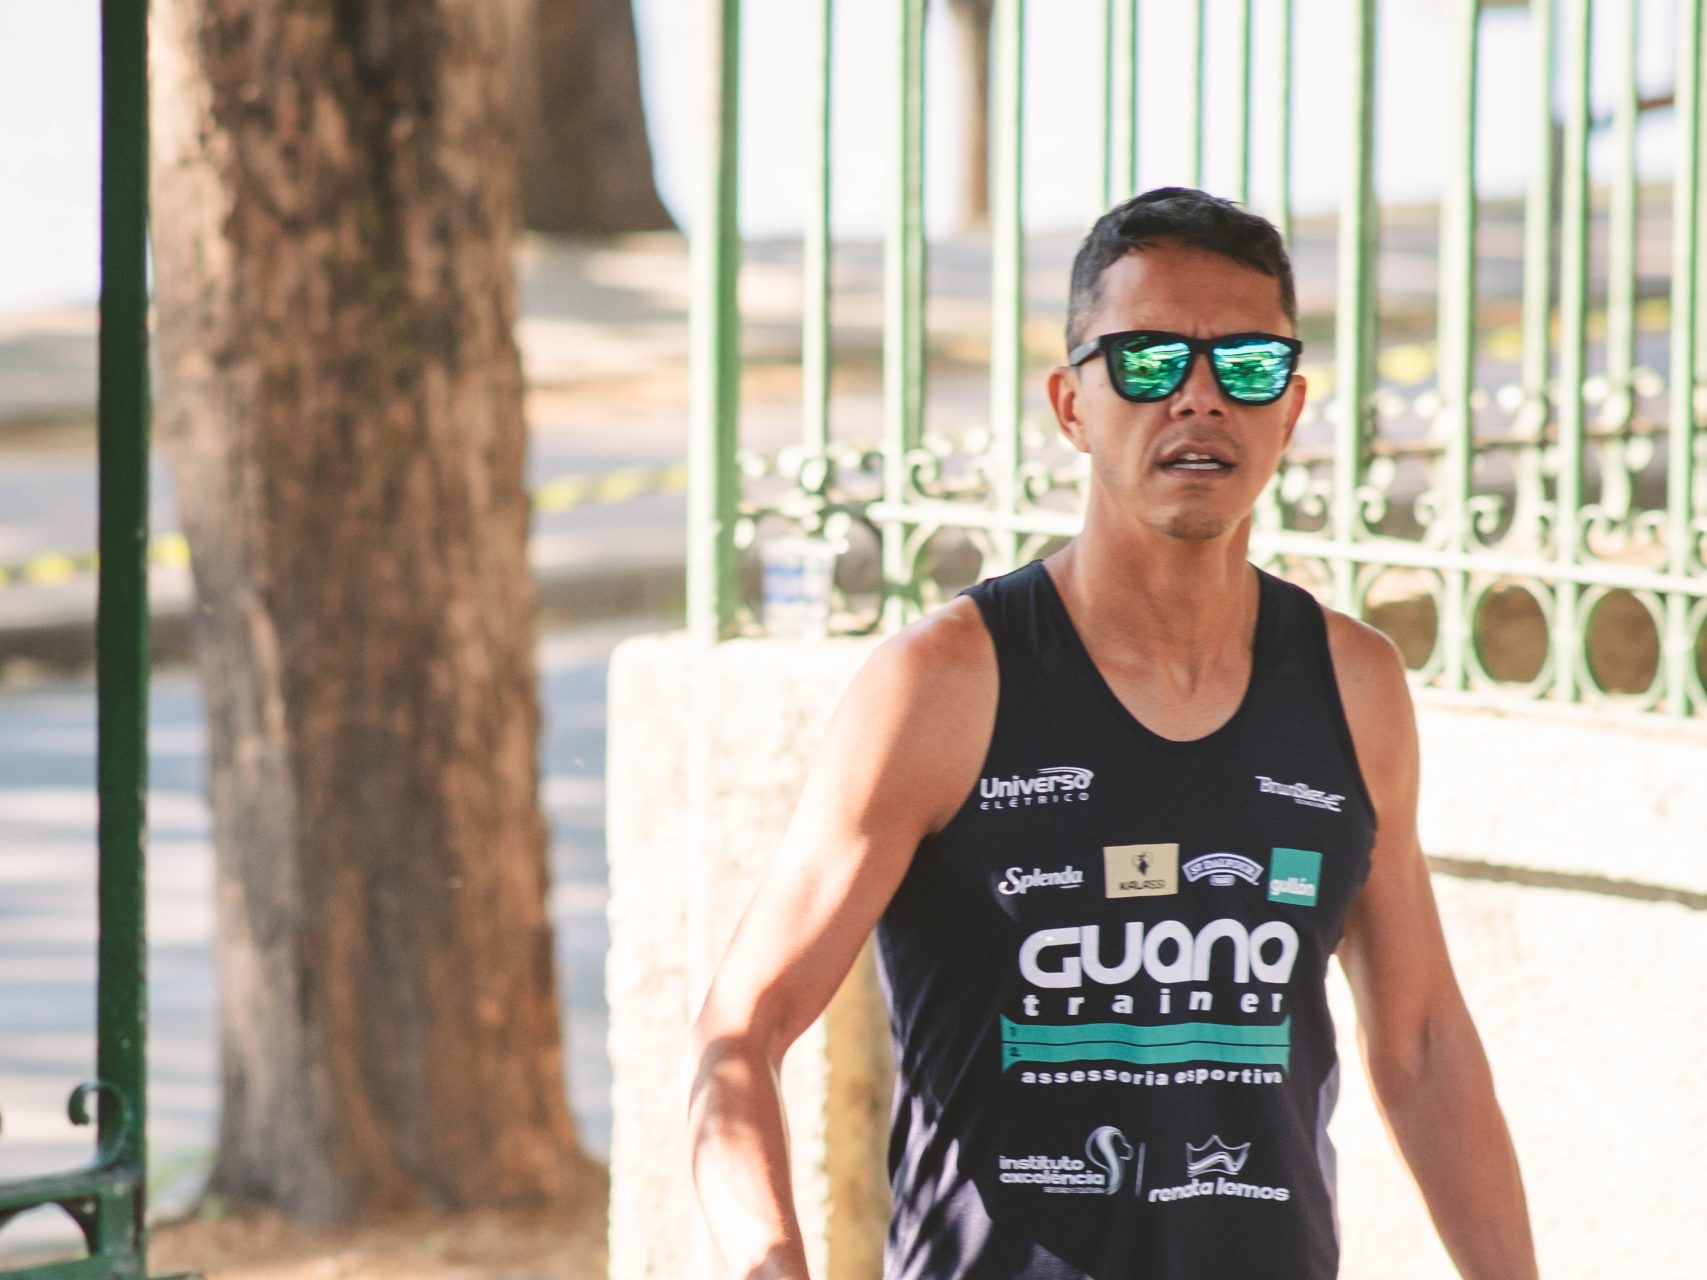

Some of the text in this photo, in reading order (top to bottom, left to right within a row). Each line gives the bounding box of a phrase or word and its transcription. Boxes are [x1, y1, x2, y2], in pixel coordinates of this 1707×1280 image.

[980, 774, 1091, 798] Universo
[998, 865, 1084, 895] Splenda
[1022, 988, 1283, 1017] trainer
[1021, 1068, 1169, 1086] assessoria
[999, 1155, 1085, 1170] instituto
[999, 1170, 1105, 1185] excelência
[1147, 1176, 1290, 1202] renata lemos
